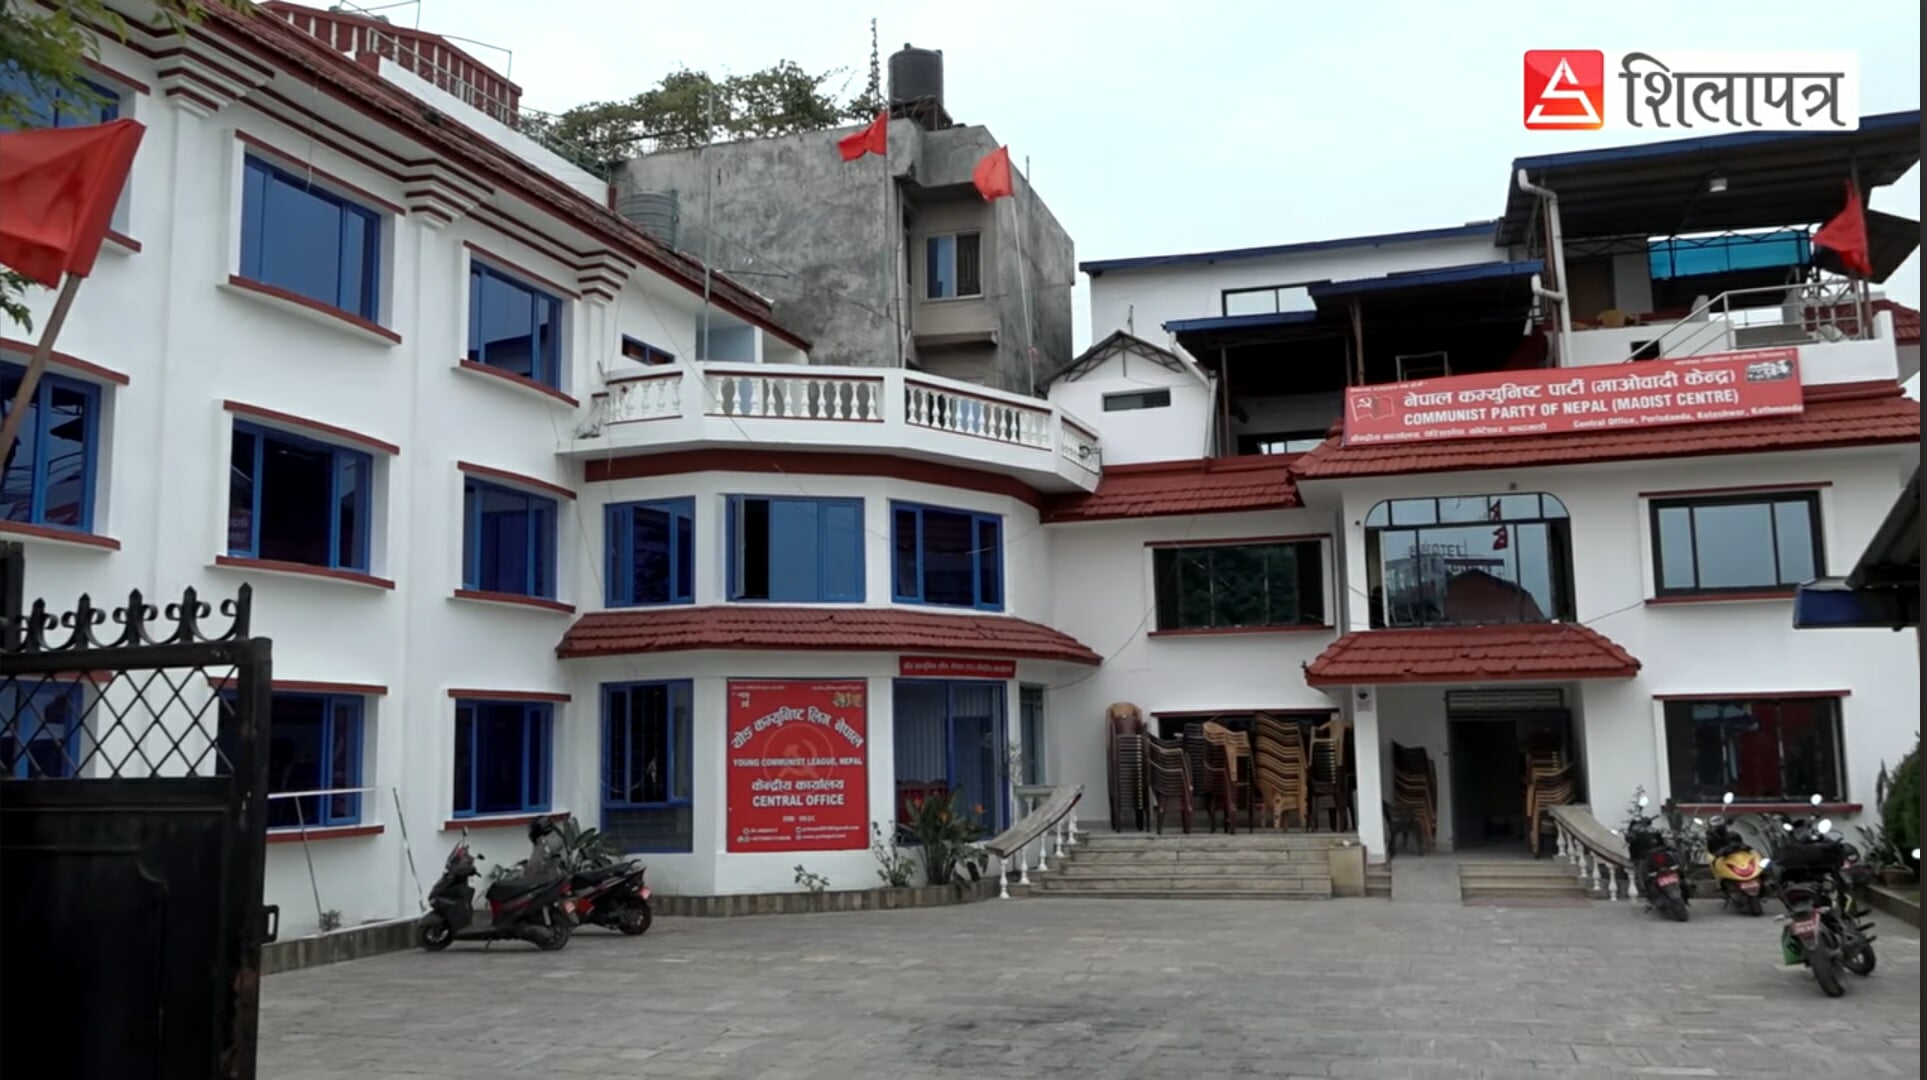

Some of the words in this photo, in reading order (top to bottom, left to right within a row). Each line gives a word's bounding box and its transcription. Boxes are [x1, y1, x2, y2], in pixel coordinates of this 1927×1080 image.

[1403, 391, 1452, 408] नेपाल
[1458, 382, 1543, 405] कम्युनिष्ट
[1548, 377, 1585, 397] पार्टी
[1591, 372, 1679, 393] (माओवादी
[1403, 407, 1488, 426] COMMUNIST
[1491, 404, 1537, 420] PARTY
[1540, 402, 1559, 417] OF
[1562, 400, 1609, 415] NEPAL
[1612, 395, 1671, 413] (MAOIST
[1676, 389, 1740, 408] CENTRE)
[835, 719, 864, 748] नेपाल
[734, 759, 760, 767] YOUNG
[761, 758, 806, 767] COMMUNIST
[839, 757, 864, 766] NEPAL
[753, 795, 803, 807] CENTRAL
[806, 794, 844, 805] OFFICE
